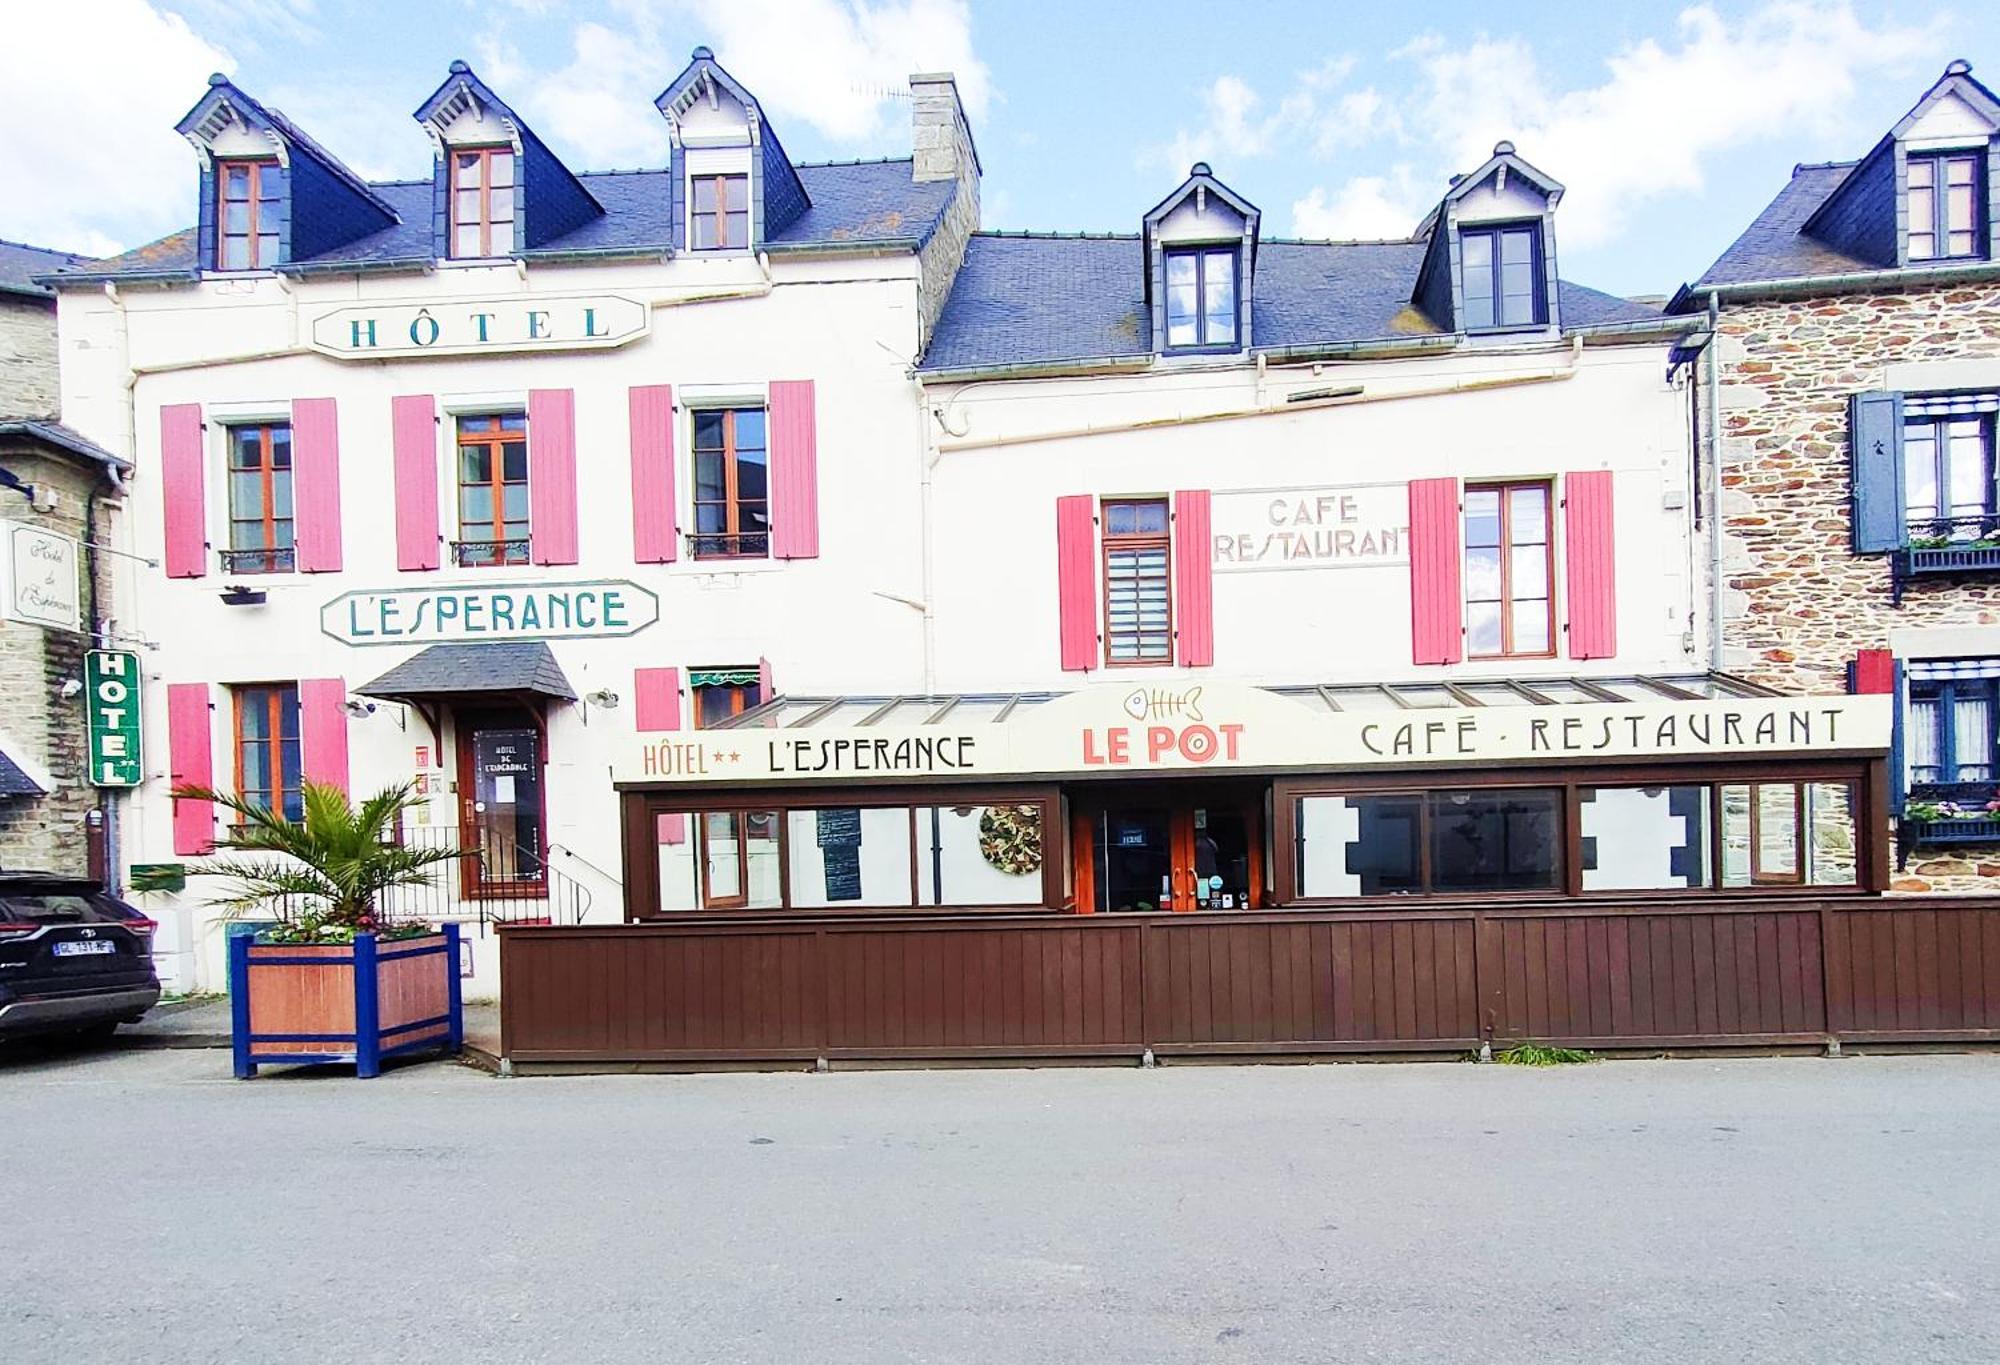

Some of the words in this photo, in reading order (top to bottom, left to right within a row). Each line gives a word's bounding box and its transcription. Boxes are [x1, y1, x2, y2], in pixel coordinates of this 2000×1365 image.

[349, 308, 611, 347] HÔTEL
[1267, 495, 1359, 527] CAFE
[349, 591, 629, 637] L'ESPERANCE
[98, 652, 128, 784] HOTEL
[1361, 714, 1477, 756] CAFÉ
[1531, 709, 1845, 751] RESTAURANT
[643, 738, 709, 775] HÔTEL
[769, 737, 976, 771] L'ESPERANCE
[1083, 727, 1130, 765] LE
[1147, 723, 1245, 763] POT
